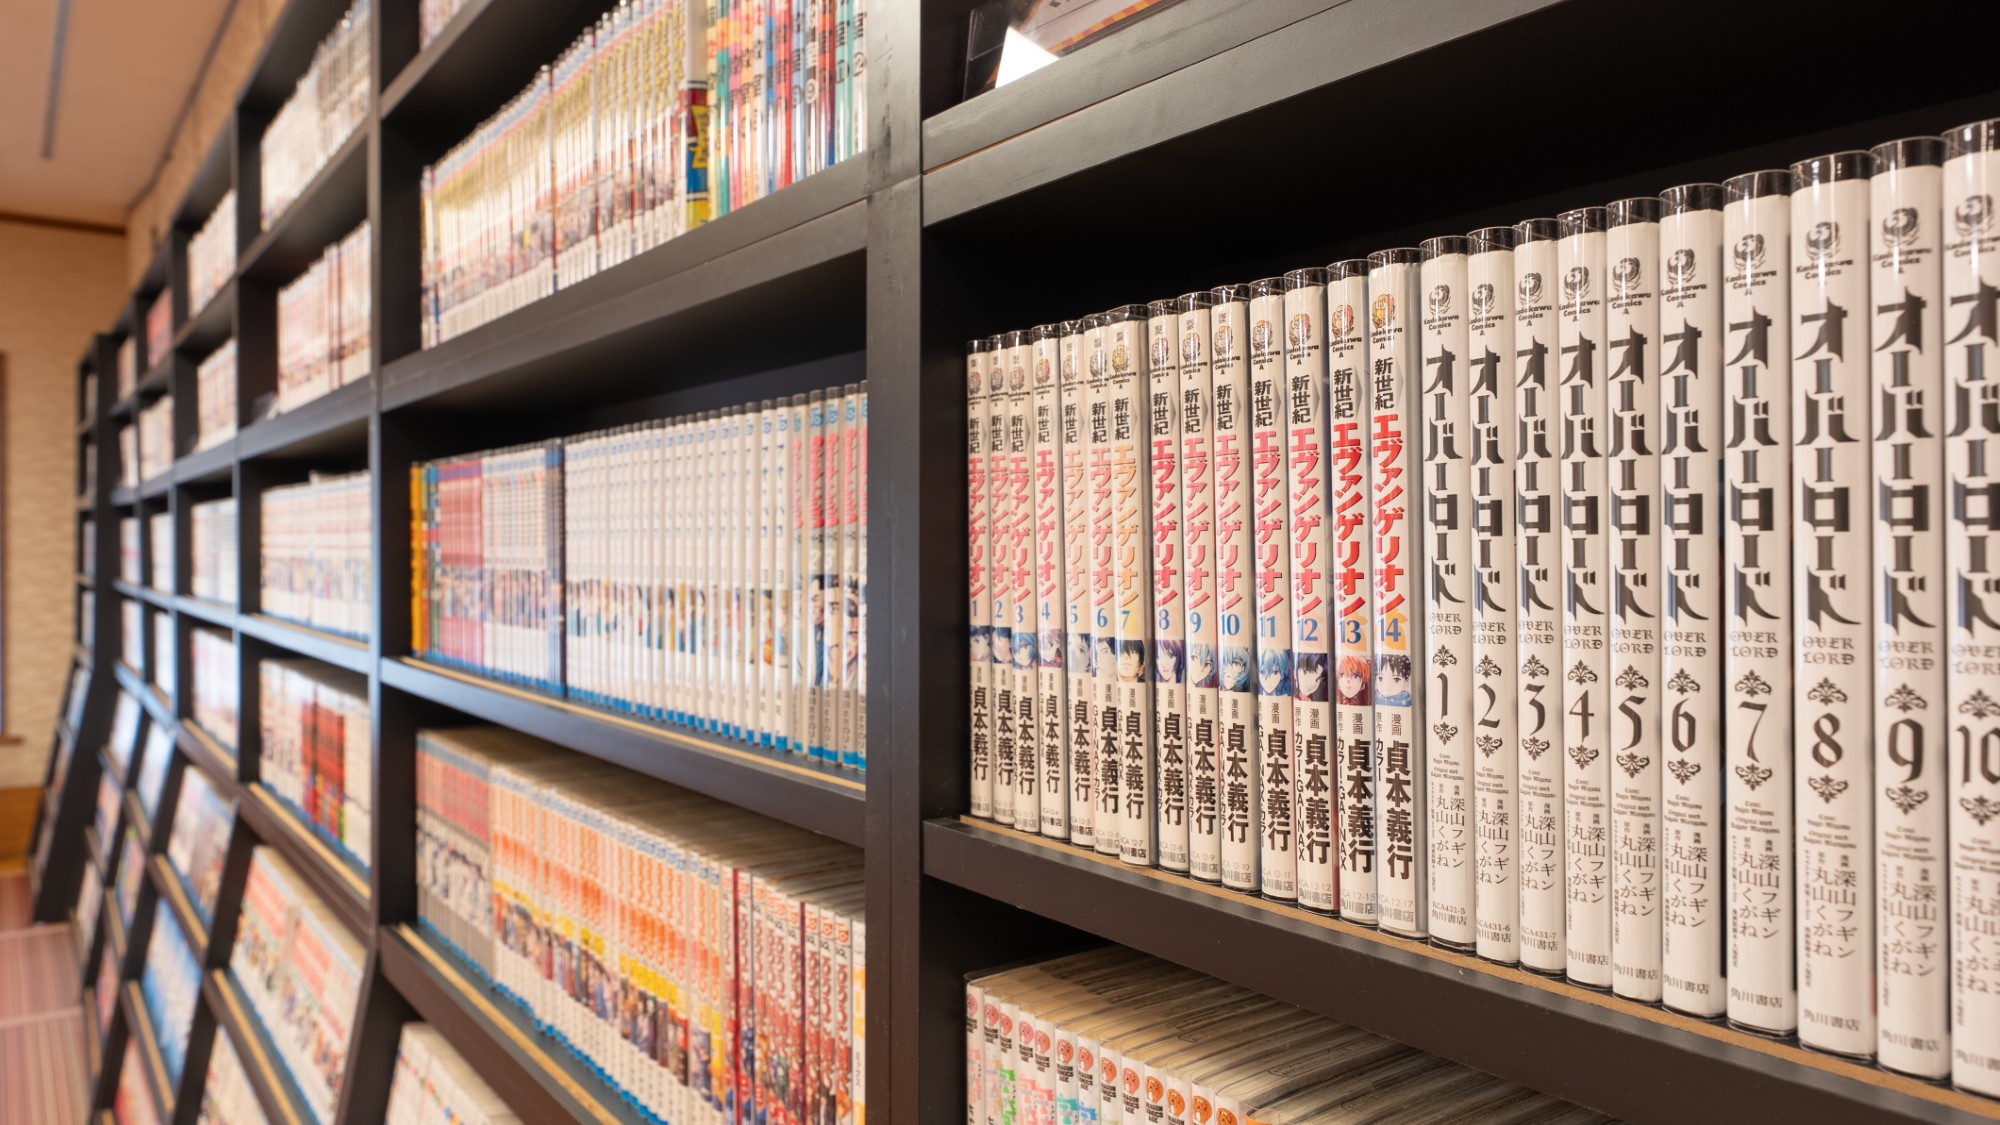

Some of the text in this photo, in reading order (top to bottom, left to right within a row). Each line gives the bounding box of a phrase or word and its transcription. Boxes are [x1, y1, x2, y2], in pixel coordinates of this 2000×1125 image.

[1423, 344, 1465, 609] オーバーロード
[1469, 345, 1507, 618] オーバーロード
[1516, 335, 1554, 616] オーバーロード
[1559, 331, 1605, 620] オーバーロード
[1608, 324, 1655, 624] オーバーロード
[1660, 317, 1709, 627] オーバーロード
[1725, 306, 1781, 626] オーバーロード
[1794, 296, 1862, 632] オーバーロード
[1874, 286, 1936, 635] オーバーロード
[972, 600, 977, 617] 1
[995, 600, 1003, 618] 2
[1015, 605, 1023, 624] 3
[1041, 602, 1050, 620] 4
[1070, 605, 1078, 624] 5
[1097, 607, 1108, 627] 6
[1121, 610, 1130, 630] 7
[1159, 609, 1170, 630] 8
[1190, 611, 1201, 633] 9
[1221, 614, 1240, 636] 10
[1260, 615, 1276, 638] 11
[1297, 618, 1318, 641] 12
[1339, 619, 1362, 644] 13
[1379, 617, 1401, 642] 14
[1429, 612, 1462, 623] OVER
[1430, 624, 1462, 635] LORD
[1473, 620, 1506, 633] OVER
[1519, 620, 1554, 632] OVER
[1564, 625, 1602, 637] OVER
[1611, 628, 1654, 640] OVER
[1664, 630, 1706, 644] OVER
[1730, 631, 1778, 643] OVER
[1473, 634, 1507, 645] LORD
[1519, 633, 1554, 645] LORD
[1564, 638, 1603, 650] LORD
[1611, 642, 1654, 654] LORD
[1664, 645, 1707, 658] LORD
[1731, 647, 1778, 658] LORD
[1802, 637, 1855, 650] OVER
[1803, 652, 1855, 666] LORD
[1879, 656, 1935, 671] LORD
[1880, 640, 1934, 654] OVER
[1952, 644, 1999, 658] OVE
[1953, 660, 1999, 676] LOR
[1309, 708, 1320, 729] 漫画
[1352, 713, 1363, 735] 漫画
[1391, 713, 1402, 736] 漫画
[1437, 672, 1448, 720] 1
[1478, 683, 1500, 728] 2
[1524, 683, 1546, 736] 3
[1568, 689, 1594, 744] 4
[1618, 695, 1647, 750] 5
[1671, 698, 1696, 752] 6
[973, 686, 989, 781] 貞本義行
[998, 689, 1014, 786] 貞本義行
[1018, 696, 1035, 796] 貞本義行
[1045, 695, 1060, 794] 貞本義行
[1073, 699, 1091, 803] 貞本義行
[1100, 705, 1119, 814] 貞本義行
[1738, 701, 1768, 764] 7
[1811, 712, 1843, 768] 8
[1888, 717, 1924, 784] 9
[1125, 711, 1144, 820] 貞本義行
[1163, 712, 1185, 826] 貞本義行
[1194, 718, 1217, 835] 貞本義行
[1226, 722, 1249, 844] 貞本義行
[1266, 728, 1291, 852] 貞本義行
[1304, 734, 1331, 865] 貞本義行
[1347, 738, 1375, 874] 貞本義行
[1385, 740, 1413, 880] 貞本義行
[1435, 795, 1449, 868] 丸山くがね
[1450, 797, 1466, 870] 深山フギン
[1478, 808, 1492, 885] 丸山くがね
[1492, 812, 1510, 885] 深山フギン
[1524, 812, 1539, 891] 丸山くがね
[1538, 814, 1557, 892] 深山フギン
[1571, 824, 1588, 904] 丸山くがね
[1587, 825, 1607, 904] 深山フギン
[1619, 834, 1638, 917] 丸山くがね
[1637, 836, 1657, 917] 深山フギン
[1670, 842, 1688, 927] 丸山くがね
[1687, 845, 1708, 929] 深山フギン
[1738, 850, 1758, 939] 丸山くがね
[1758, 853, 1781, 939] 深山フギン
[1812, 866, 1834, 958] 丸山くがね
[1834, 869, 1857, 959] 深山フギン
[1889, 880, 1913, 977] 丸山くがね
[1913, 883, 1938, 978] 深山フギン
[1964, 894, 1989, 994] 丸山くがね
